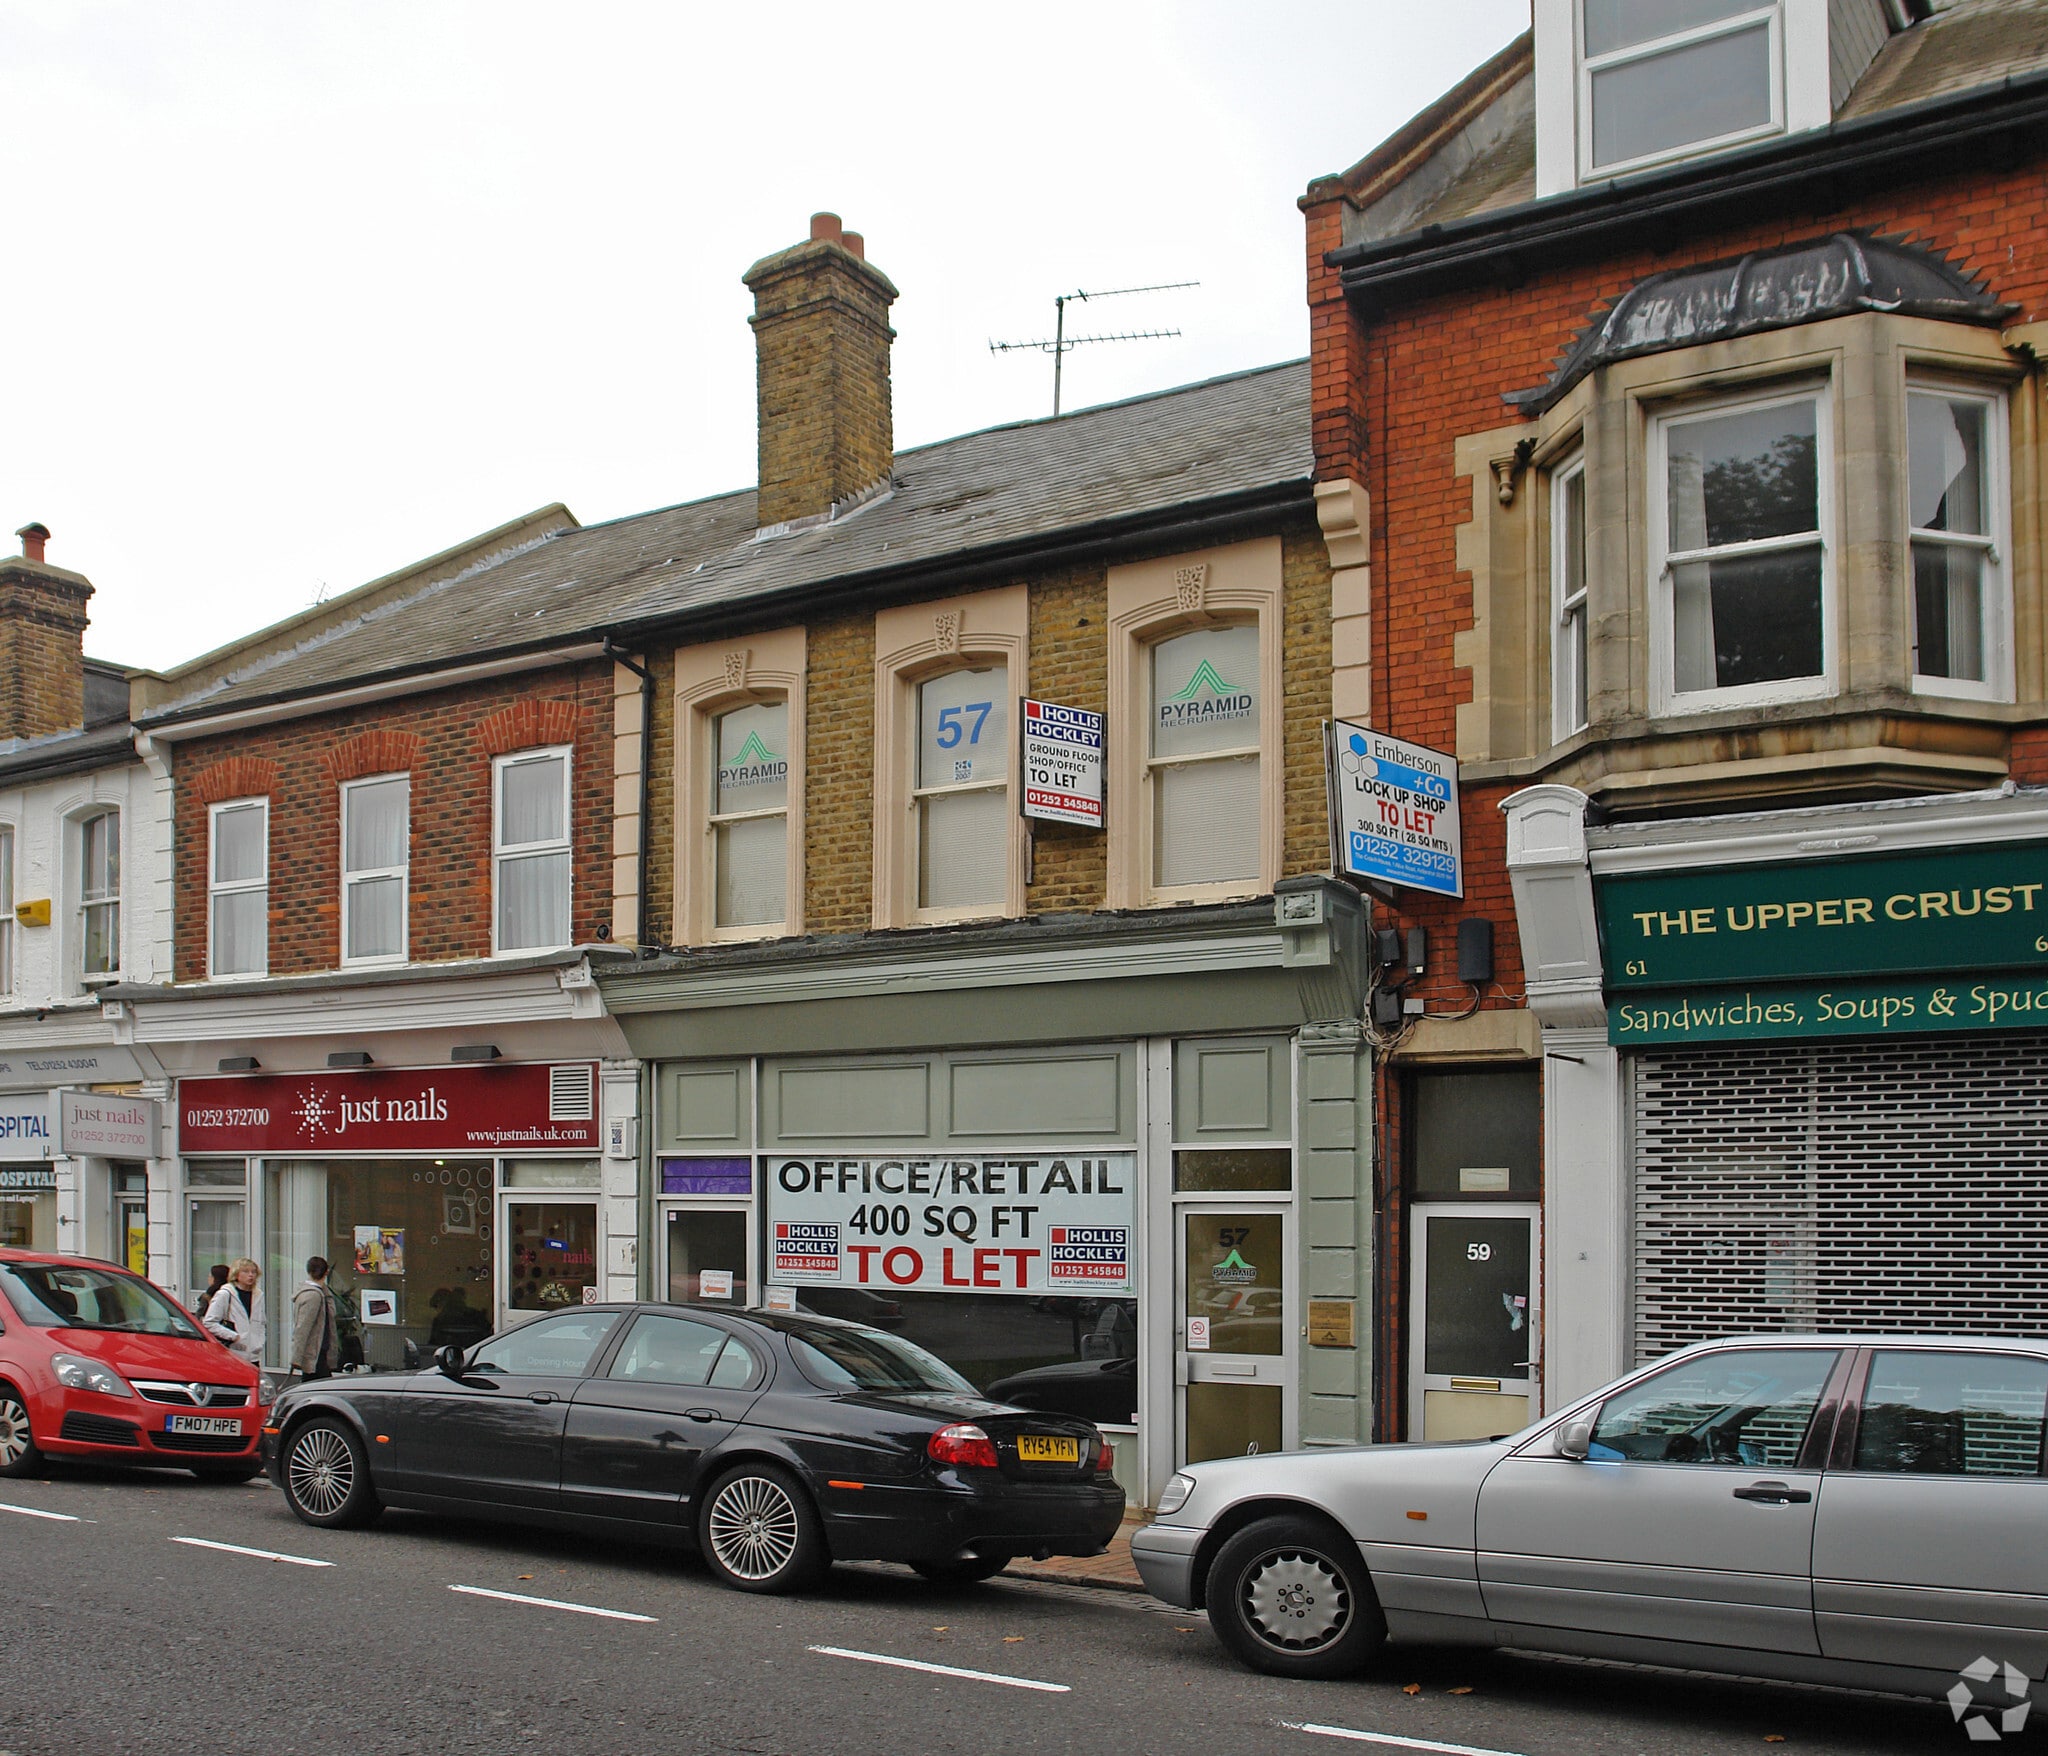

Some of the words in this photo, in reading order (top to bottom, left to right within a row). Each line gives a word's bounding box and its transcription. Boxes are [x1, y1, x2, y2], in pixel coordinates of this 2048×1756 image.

[1045, 707, 1099, 728] HOLLIS
[1161, 695, 1252, 720] PYRAMID
[937, 702, 992, 749] 57
[1161, 710, 1252, 728] RECRUITMENT
[1029, 721, 1098, 745] HOCKLEY
[1030, 743, 1070, 758] GROUND
[1072, 751, 1099, 764] FLOOR
[1374, 740, 1441, 775] Emberson
[720, 762, 788, 782] PYRAMID
[1029, 755, 1087, 773] SHOP/OFFICE
[720, 775, 788, 790] RECRUITMENT
[1030, 768, 1049, 784] TO
[1054, 772, 1077, 789] LET
[1414, 775, 1444, 797] +Co
[1029, 792, 1061, 806] 01252
[1063, 798, 1098, 812] 545848
[1355, 776, 1391, 800] LOCK
[1394, 789, 1409, 805] UP
[1413, 795, 1446, 814] SHOP
[1377, 800, 1399, 826] TO
[1404, 808, 1435, 835] LET
[1358, 819, 1374, 833] 300
[1376, 824, 1389, 838] SQ
[1389, 828, 1399, 839] FT
[1406, 832, 1416, 843] 28
[1418, 835, 1431, 847] SQ
[1432, 839, 1448, 851] MTS
[1353, 834, 1399, 860] 01252
[1402, 847, 1455, 873] 329129
[1632, 907, 1717, 937] THE
[1726, 897, 1876, 931] UPPER
[1884, 882, 2043, 921] CRUST
[1625, 960, 1648, 976] 61
[1619, 992, 1804, 1032] Sandwiches,
[1817, 993, 1916, 1027] Soups
[1927, 988, 1958, 1017] &
[71, 1105, 102, 1124] just
[106, 1109, 145, 1125] nails
[187, 1110, 223, 1127] 01252
[225, 1108, 270, 1126] 372700
[335, 1094, 381, 1133] just
[386, 1087, 448, 1121] nails
[71, 1130, 104, 1141] 01252
[107, 1132, 145, 1145] 372700
[466, 1126, 587, 1145] www.justnails.uk.com
[778, 1160, 1123, 1198] OFFICE/RETAIL
[791, 1226, 837, 1238] HOLLIS
[849, 1204, 910, 1236] 400
[923, 1205, 977, 1244] SQ
[991, 1206, 1039, 1238] FT
[1070, 1230, 1124, 1242] HOLLIS
[1219, 1228, 1249, 1247] 57
[777, 1241, 837, 1253] HOCKLEY
[1053, 1247, 1124, 1260] HOCKLEY
[1467, 1243, 1491, 1261] 59
[778, 1257, 803, 1267] 01252
[805, 1258, 836, 1268] 545848
[847, 1245, 924, 1285] TO
[943, 1247, 1040, 1288] LET
[1053, 1265, 1084, 1275] 01252
[1087, 1266, 1123, 1276] 545848
[1212, 1268, 1257, 1278] PYRAMID
[175, 1417, 210, 1430] FM07
[213, 1420, 237, 1433] HPE
[1023, 1437, 1051, 1455] RY54
[1052, 1438, 1074, 1456] YFN
